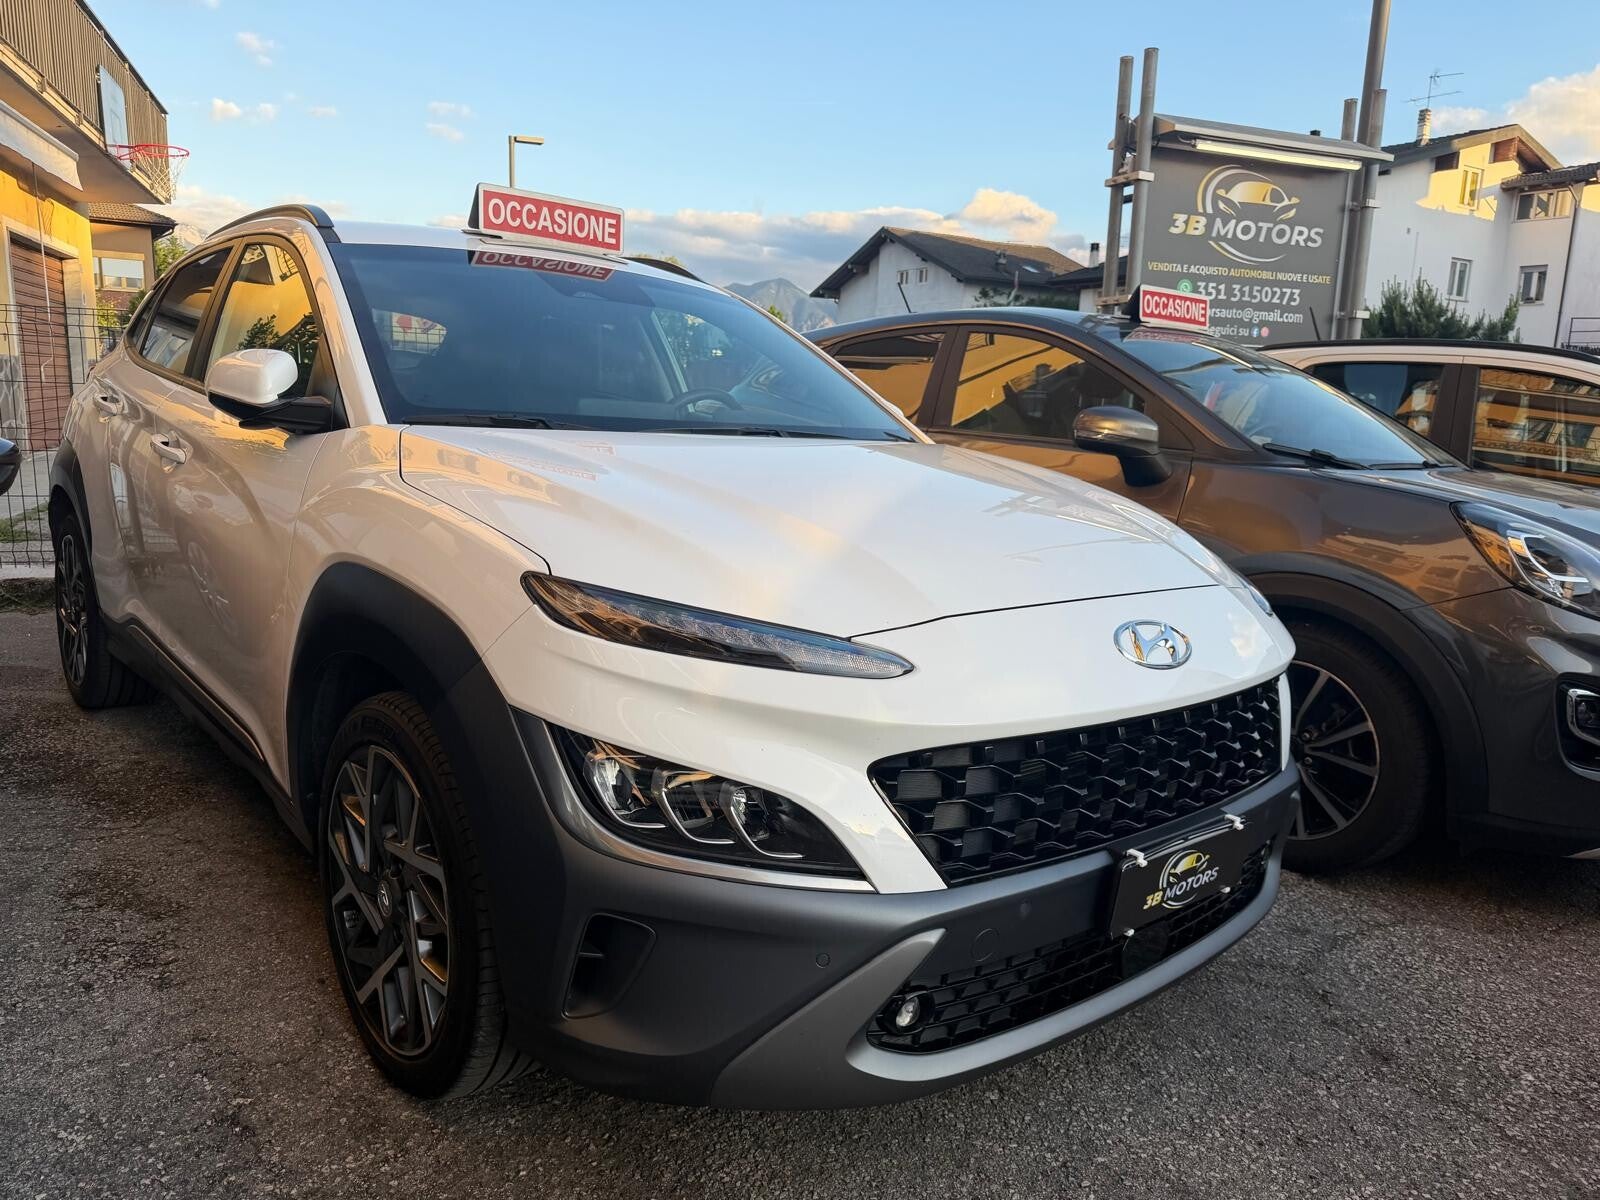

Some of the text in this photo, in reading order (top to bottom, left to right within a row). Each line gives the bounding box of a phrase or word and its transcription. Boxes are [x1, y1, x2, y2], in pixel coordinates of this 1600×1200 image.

[488, 198, 617, 245] OCCASIONE
[1168, 212, 1324, 248] 3B MOTORS
[1147, 261, 1332, 284] VENDITA E ACQUISTO AUTOMOBILI NUOVE E USATE
[1197, 282, 1301, 306] 351 3150273
[1143, 294, 1206, 322] OCCASIONE
[1208, 307, 1303, 324] rsauto@gmail.com
[1206, 324, 1237, 338] eguici
[1143, 867, 1219, 910] 3B MOTORS
